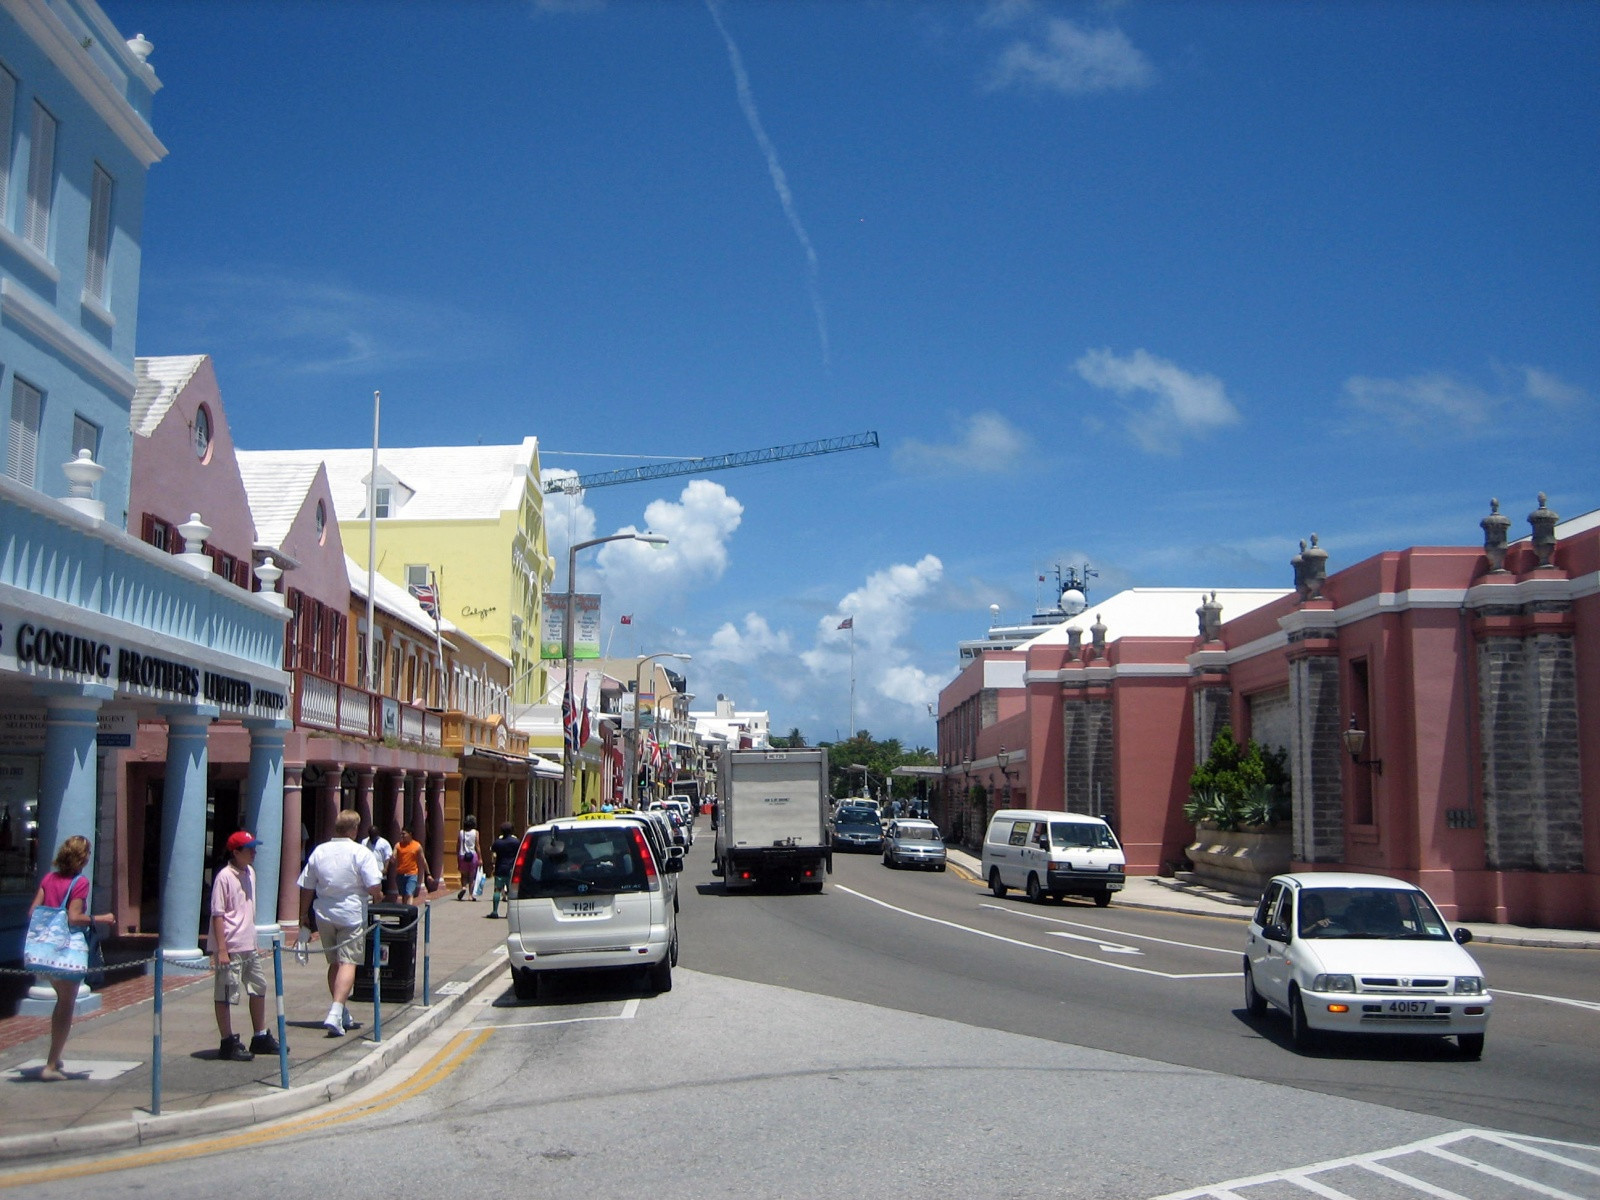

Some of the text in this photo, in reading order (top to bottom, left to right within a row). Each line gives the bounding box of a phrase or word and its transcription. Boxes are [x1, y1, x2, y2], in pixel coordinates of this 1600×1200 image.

[461, 605, 496, 620] Calypso
[16, 623, 111, 679] GOSLING
[118, 648, 200, 697] BROTHERS
[204, 671, 251, 707] LIMITED
[254, 688, 284, 710] SPIRITS
[0, 713, 41, 722] ATURING
[6, 721, 47, 729] SELECTIO
[572, 902, 595, 912] T1211
[1389, 1001, 1427, 1012] 40157
